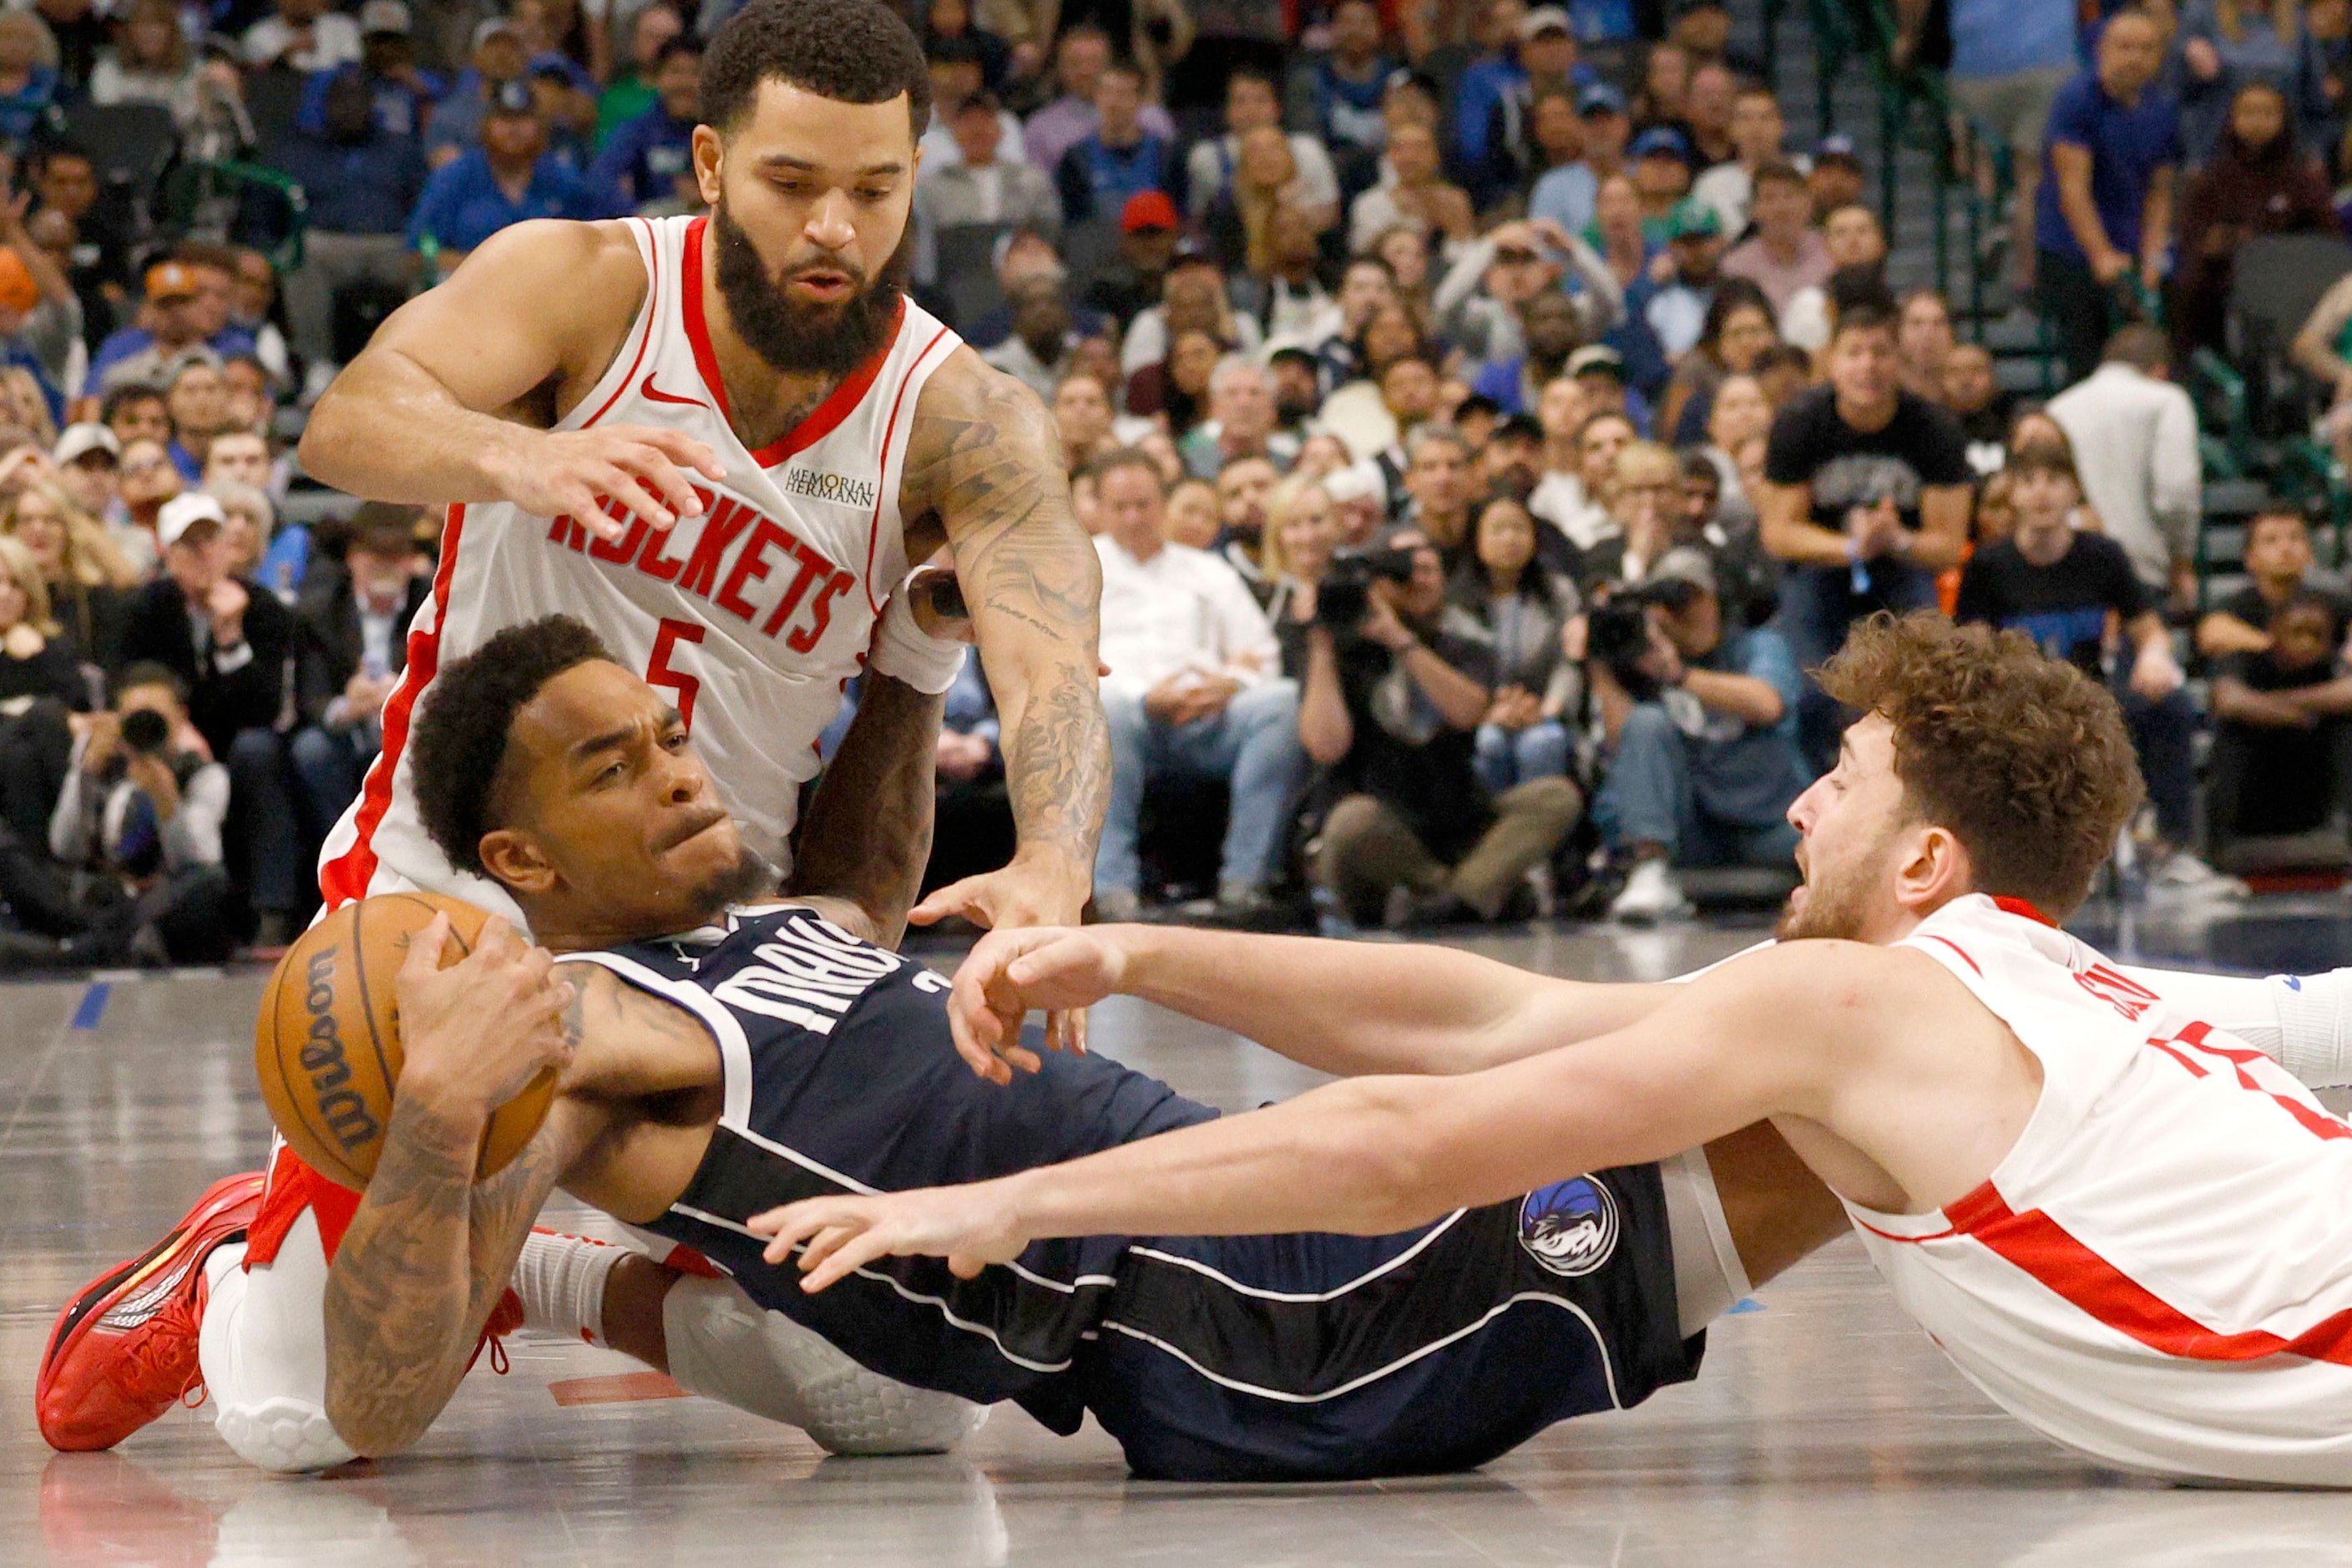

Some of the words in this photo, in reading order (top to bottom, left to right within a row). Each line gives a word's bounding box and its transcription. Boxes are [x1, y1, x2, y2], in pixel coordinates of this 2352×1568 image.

[785, 478, 874, 507] HERMANN
[787, 467, 873, 496] MEMORIAL
[646, 616, 706, 735] 5
[298, 943, 379, 1154] Wilson
